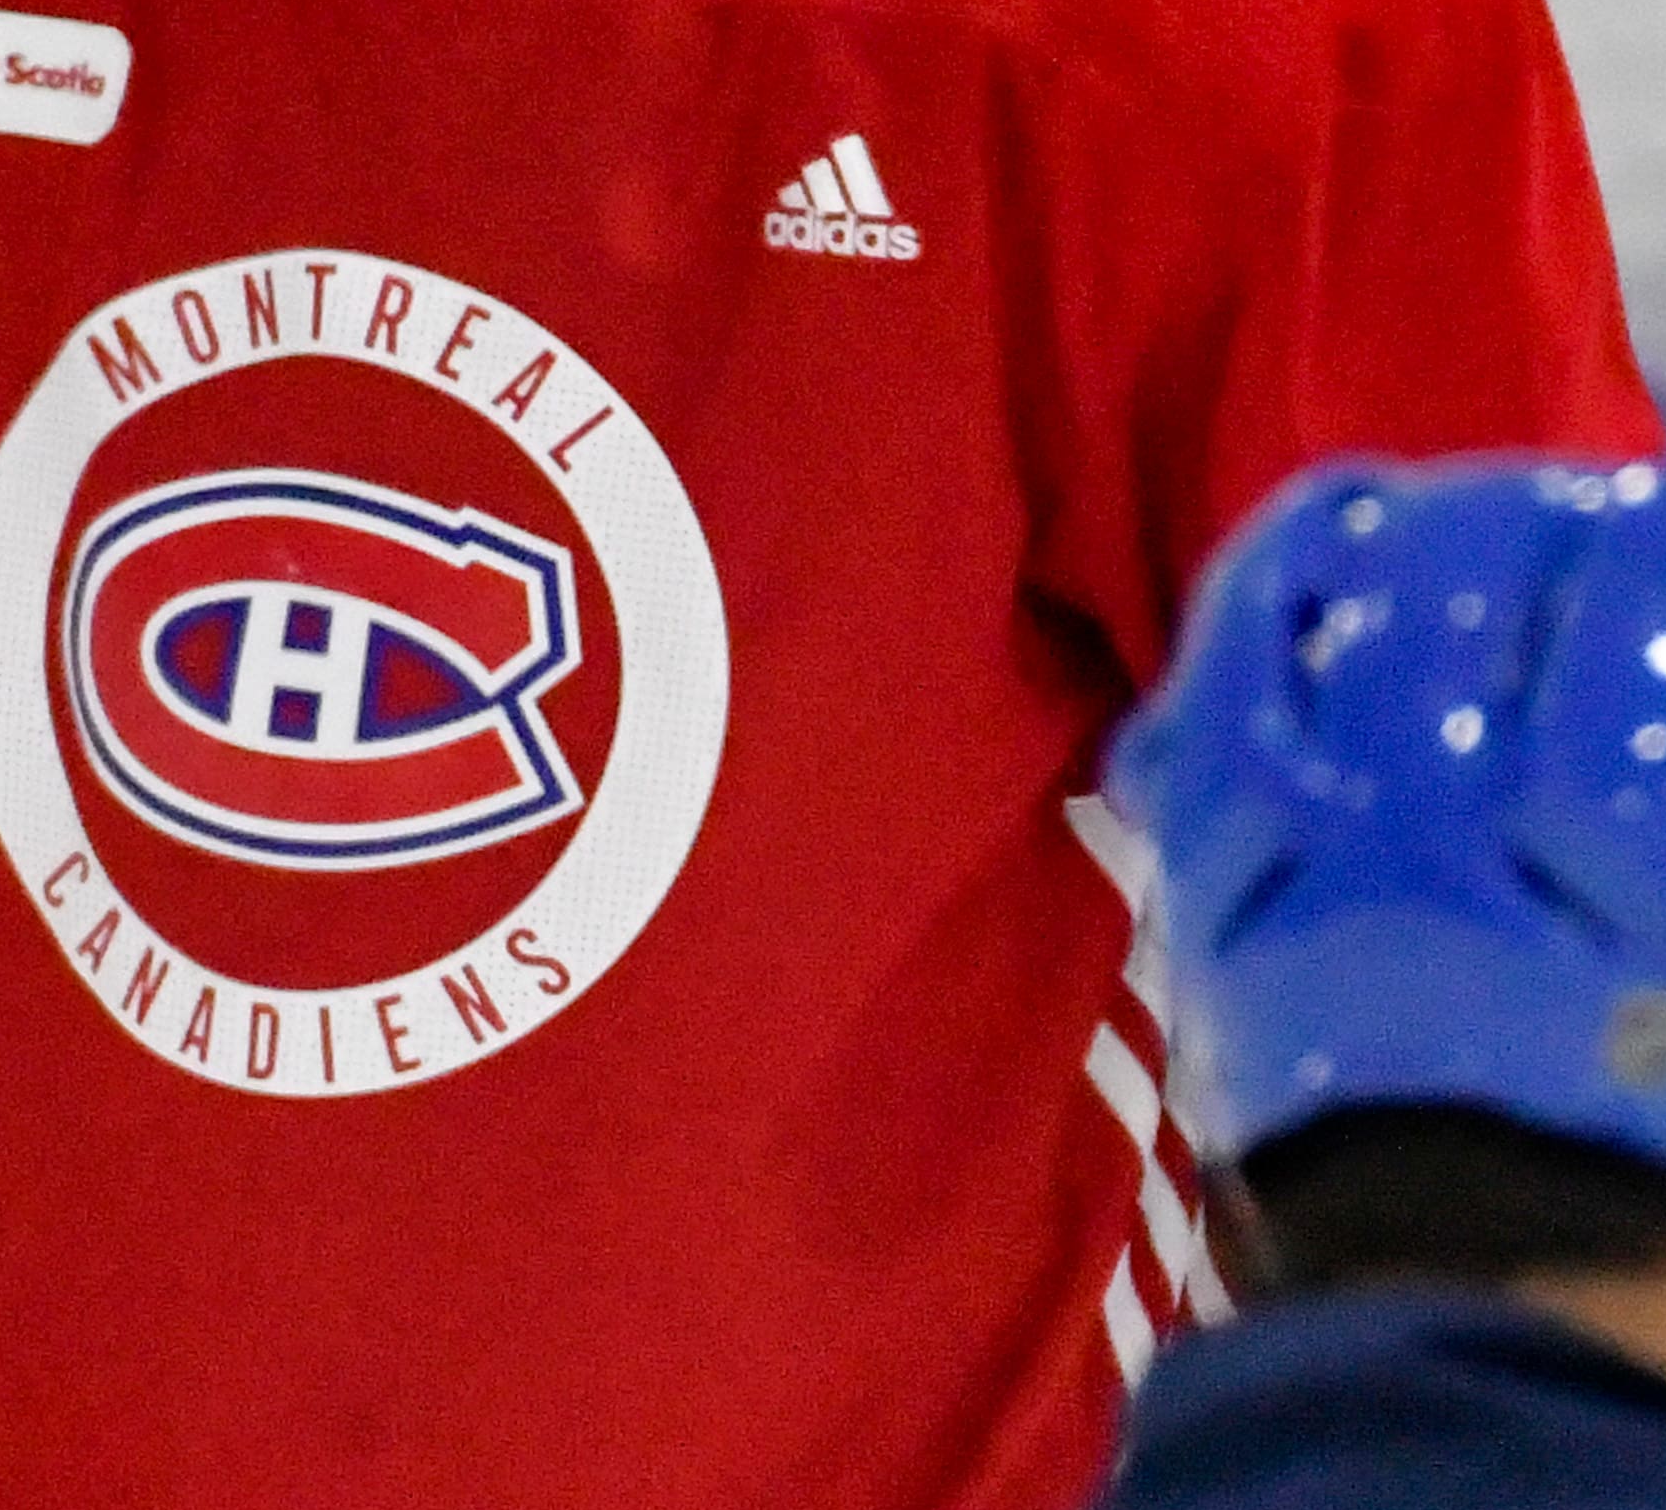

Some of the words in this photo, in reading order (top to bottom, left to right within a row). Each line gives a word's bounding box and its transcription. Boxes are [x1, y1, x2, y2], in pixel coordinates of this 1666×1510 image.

[764, 207, 922, 262] adidas
[86, 263, 614, 476] MONTREAL
[42, 850, 573, 1084] CANADIENS
